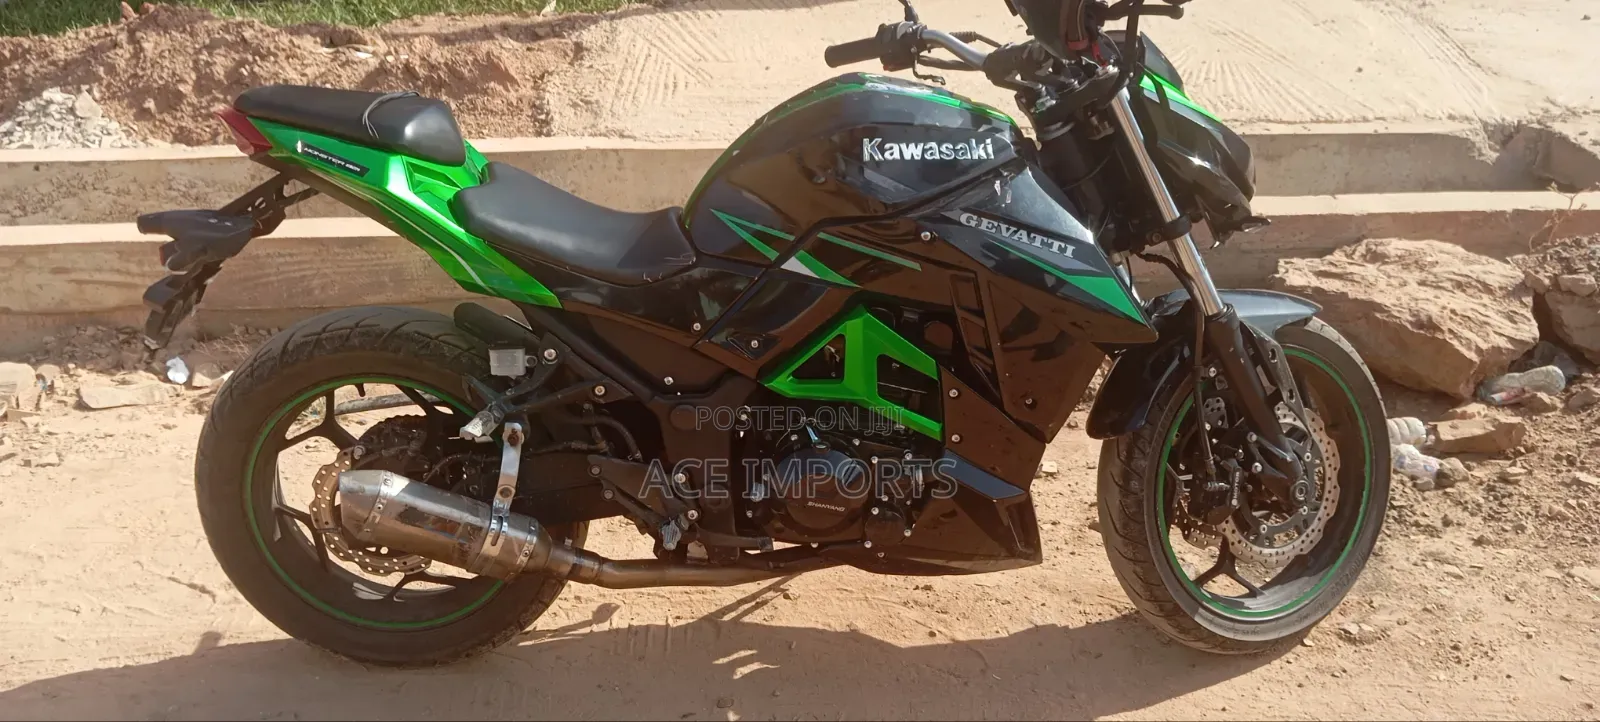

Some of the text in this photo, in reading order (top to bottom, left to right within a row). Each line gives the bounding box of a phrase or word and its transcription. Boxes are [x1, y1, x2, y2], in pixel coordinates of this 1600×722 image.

[303, 147, 345, 165] MONSTER
[862, 137, 995, 162] Kawasaki
[959, 212, 1075, 258] GEVATTI
